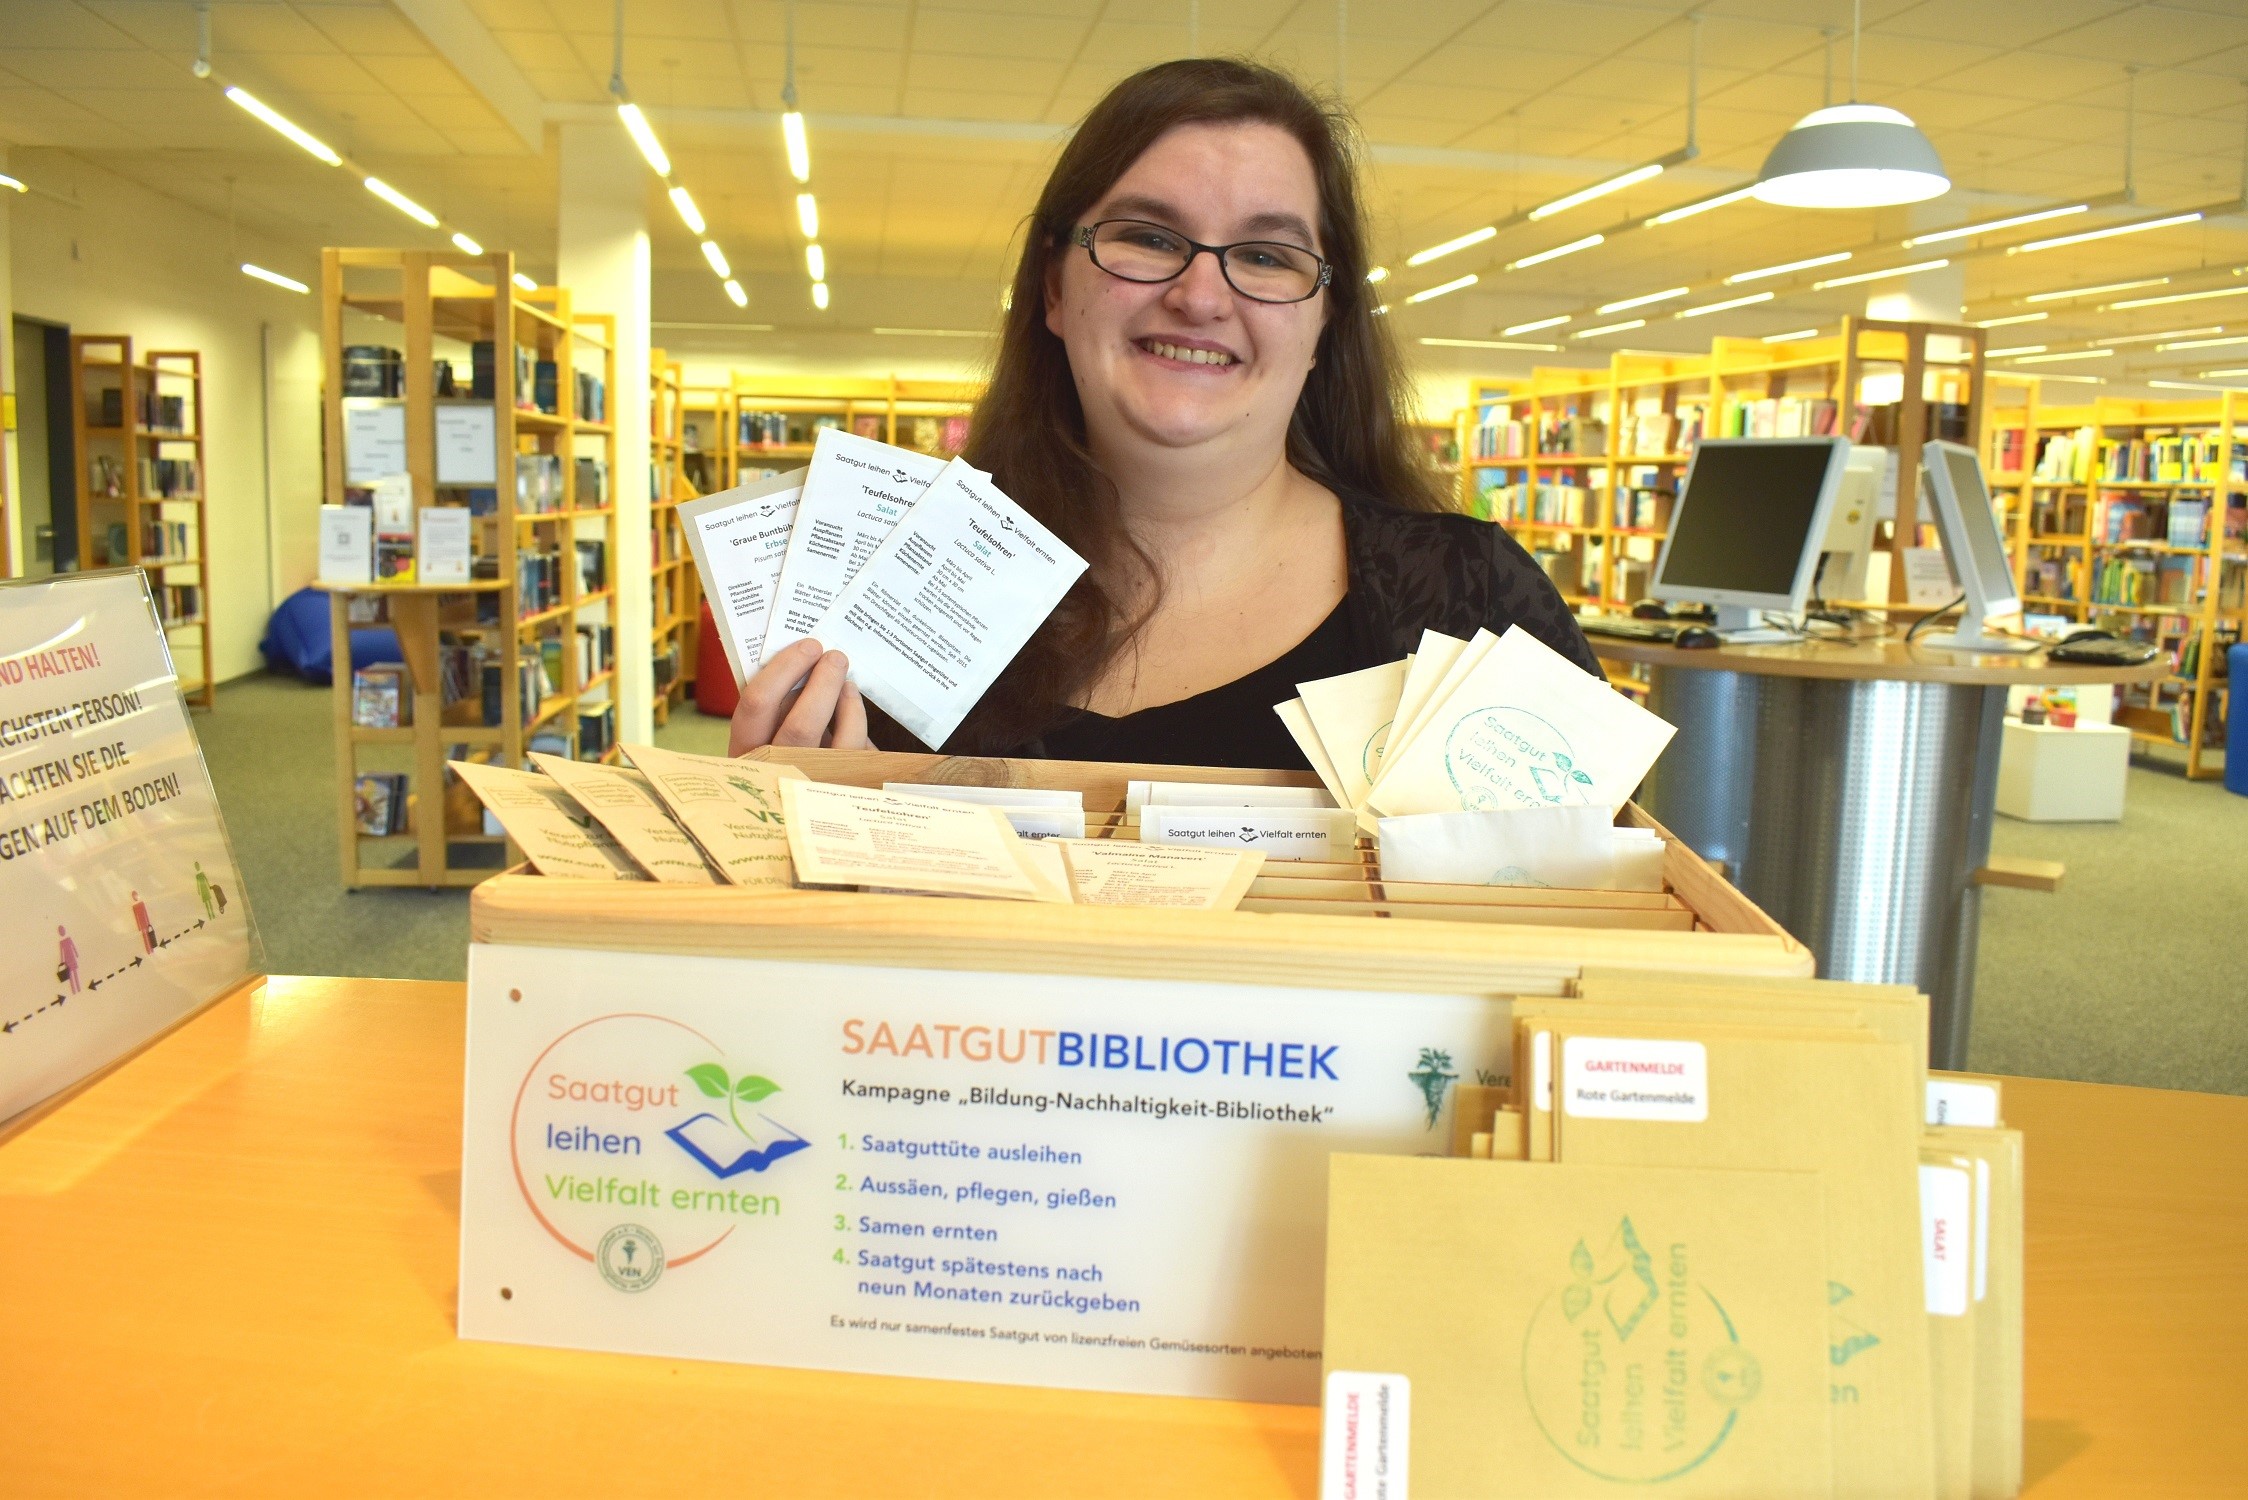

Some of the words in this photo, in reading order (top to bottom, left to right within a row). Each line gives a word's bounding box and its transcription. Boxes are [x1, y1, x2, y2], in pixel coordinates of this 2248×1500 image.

[835, 453, 866, 468] Saatgut
[867, 463, 890, 475] leihen
[704, 518, 734, 531] Saatgut
[735, 511, 758, 521] leihen
[815, 518, 843, 531] Voranzucht
[856, 510, 882, 522] Lactuca
[875, 503, 897, 516] Salat
[956, 479, 982, 503] Saatgut
[981, 500, 1000, 518] leihen
[1014, 527, 1035, 548] Vielfalt
[1035, 546, 1055, 565] ernten
[729, 534, 757, 546] 'Graue
[764, 538, 788, 549] Erbse
[808, 540, 839, 553] Küchenernte
[810, 532, 845, 547] Pflanzabstand
[812, 526, 843, 538] Auspflanzen
[968, 517, 1015, 558] 'Teufelsohren'
[754, 552, 777, 563] Pisum
[898, 547, 924, 570] Küchenernte
[903, 541, 932, 566] Pflanzabstand
[953, 538, 975, 557] Lactuca
[973, 556, 991, 571] sativa
[972, 540, 991, 557] Salat
[734, 598, 764, 610] Küchenernte
[863, 611, 879, 626] bringen
[25, 643, 101, 680] HALTEN!
[72, 688, 143, 730] PERSON!
[1483, 716, 1547, 762] Saatgut
[73, 750, 101, 779] SIE
[100, 742, 131, 771] DIE
[1459, 749, 1512, 792] Vielfalt
[0, 824, 40, 861] GEN
[43, 808, 78, 845] AUF
[81, 798, 123, 830] DEM
[122, 772, 182, 815] BODEN!
[1168, 829, 1205, 839] Saatgut
[1208, 829, 1236, 838] leihen
[1260, 830, 1293, 839] Vielfalt
[1295, 831, 1327, 839] ernten
[841, 1018, 1341, 1081] SAATGUTBIBLIOTHEK
[1585, 1060, 1685, 1075] GARTENMELDE
[548, 1074, 679, 1111] Saatgut
[841, 1079, 950, 1105] Kampagne
[1577, 1088, 1606, 1102] Rote
[1610, 1090, 1696, 1105] Gartenmelde
[547, 1123, 642, 1155] leihen
[837, 1133, 855, 1151] 1.
[861, 1134, 981, 1160] Saatguttüte
[987, 1140, 1083, 1165] ausleihen
[545, 1173, 661, 1208] Vielfalt
[671, 1185, 781, 1215] ernten
[835, 1173, 853, 1192] 2.
[859, 1176, 949, 1200] Aussäen,
[955, 1181, 1039, 1207] pflegen,
[1046, 1188, 1116, 1210] gießen
[834, 1214, 852, 1232] 3.
[858, 1216, 926, 1238] Samen
[932, 1223, 998, 1243] ernten
[1933, 1218, 1946, 1261] SALAT
[832, 1248, 850, 1266] 4.
[857, 1249, 935, 1274] Saatgut
[941, 1256, 1050, 1282] spätestens
[1056, 1263, 1103, 1283] nach
[858, 1279, 907, 1298] neun
[913, 1282, 1003, 1305] Monaten
[1009, 1287, 1141, 1314] zurückgeben
[1669, 1242, 1689, 1340] ernten
[830, 1315, 845, 1328] Es
[848, 1317, 877, 1331] wird
[880, 1321, 901, 1333] nur
[905, 1321, 985, 1340] samenfestes
[989, 1326, 1040, 1344] Saatgut
[1044, 1332, 1067, 1344] von
[1071, 1331, 1146, 1350] lizenzfreien
[1149, 1337, 1247, 1357] Gemüsesorten
[1577, 1329, 1606, 1448] Saatgut
